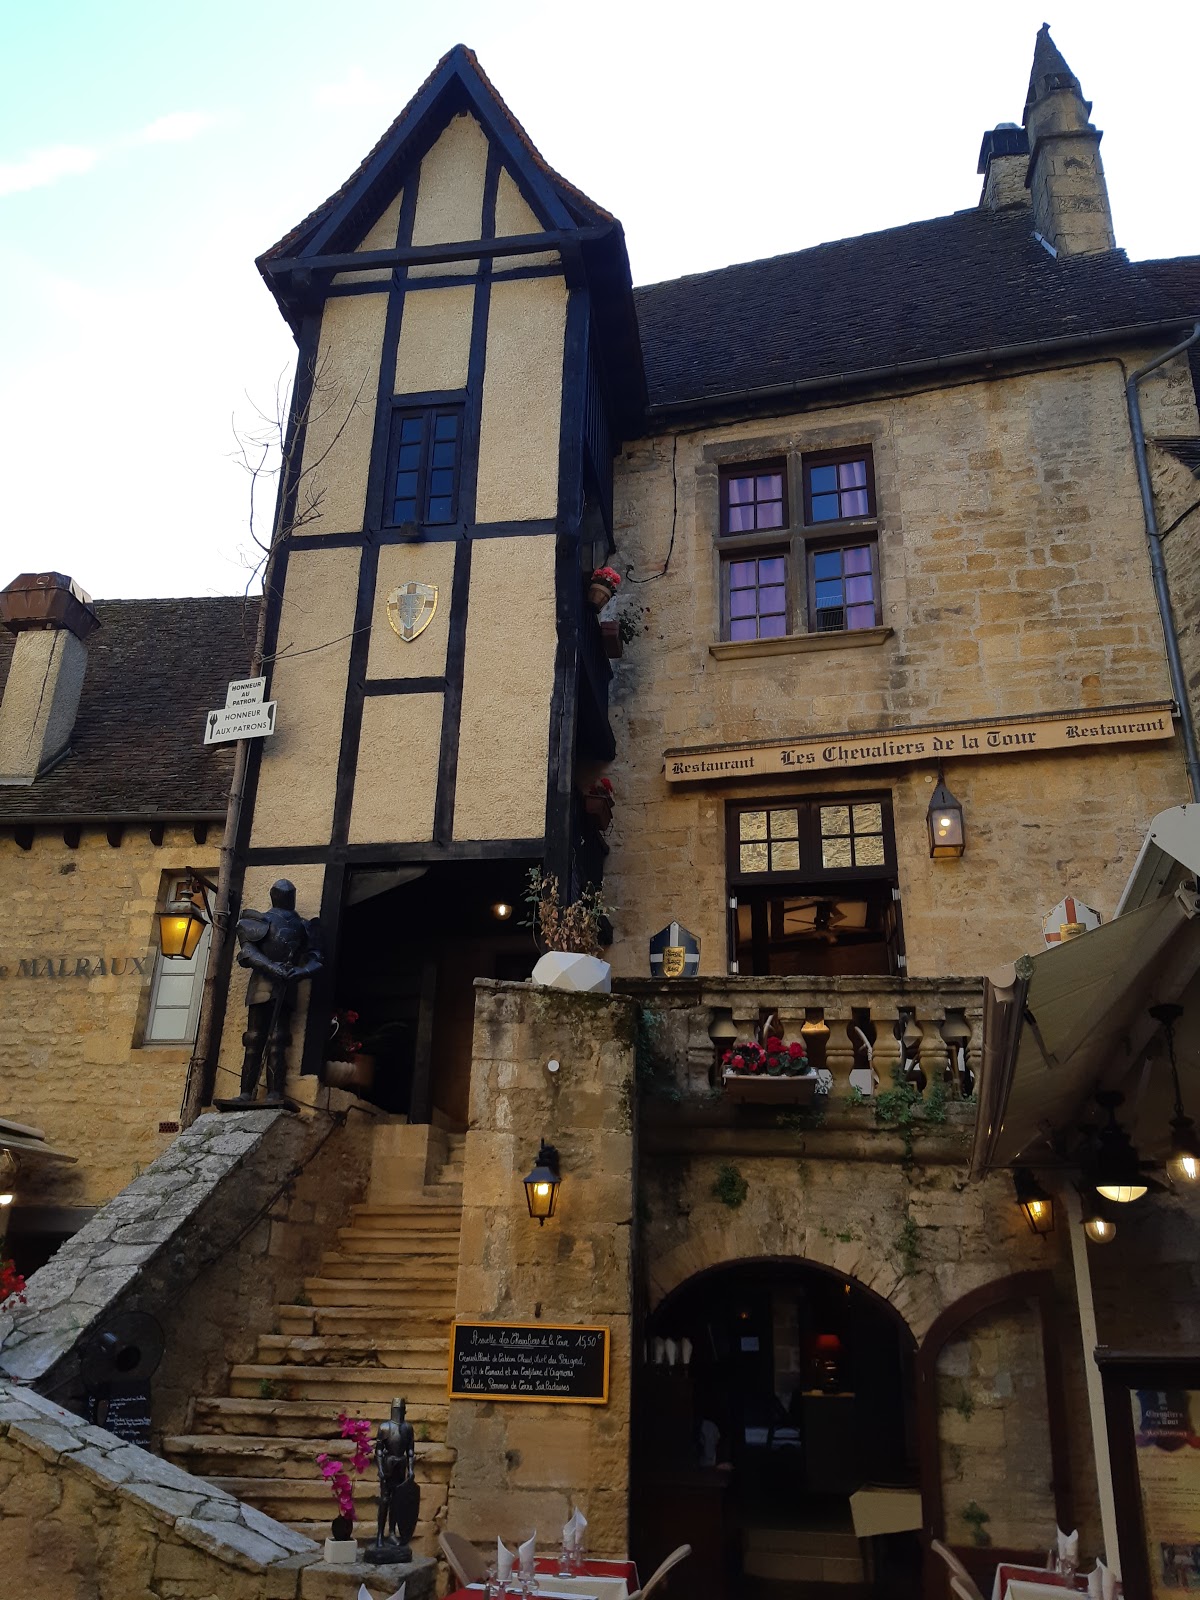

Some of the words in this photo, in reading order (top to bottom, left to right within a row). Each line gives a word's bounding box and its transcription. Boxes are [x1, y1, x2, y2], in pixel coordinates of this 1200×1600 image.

[232, 682, 262, 691] HONNEUR
[233, 698, 256, 706] PATRON
[225, 710, 261, 721] HONNEUR
[216, 727, 231, 735] AUX
[233, 722, 267, 732] PATRONS
[672, 756, 755, 774] Restaurant
[781, 750, 815, 766] Les
[823, 741, 925, 763] Chevaliers
[933, 736, 954, 751] de
[962, 734, 979, 749] la
[987, 731, 1036, 747] Tour
[1066, 719, 1165, 738] Restaurant
[16, 957, 147, 978] MALRAUX
